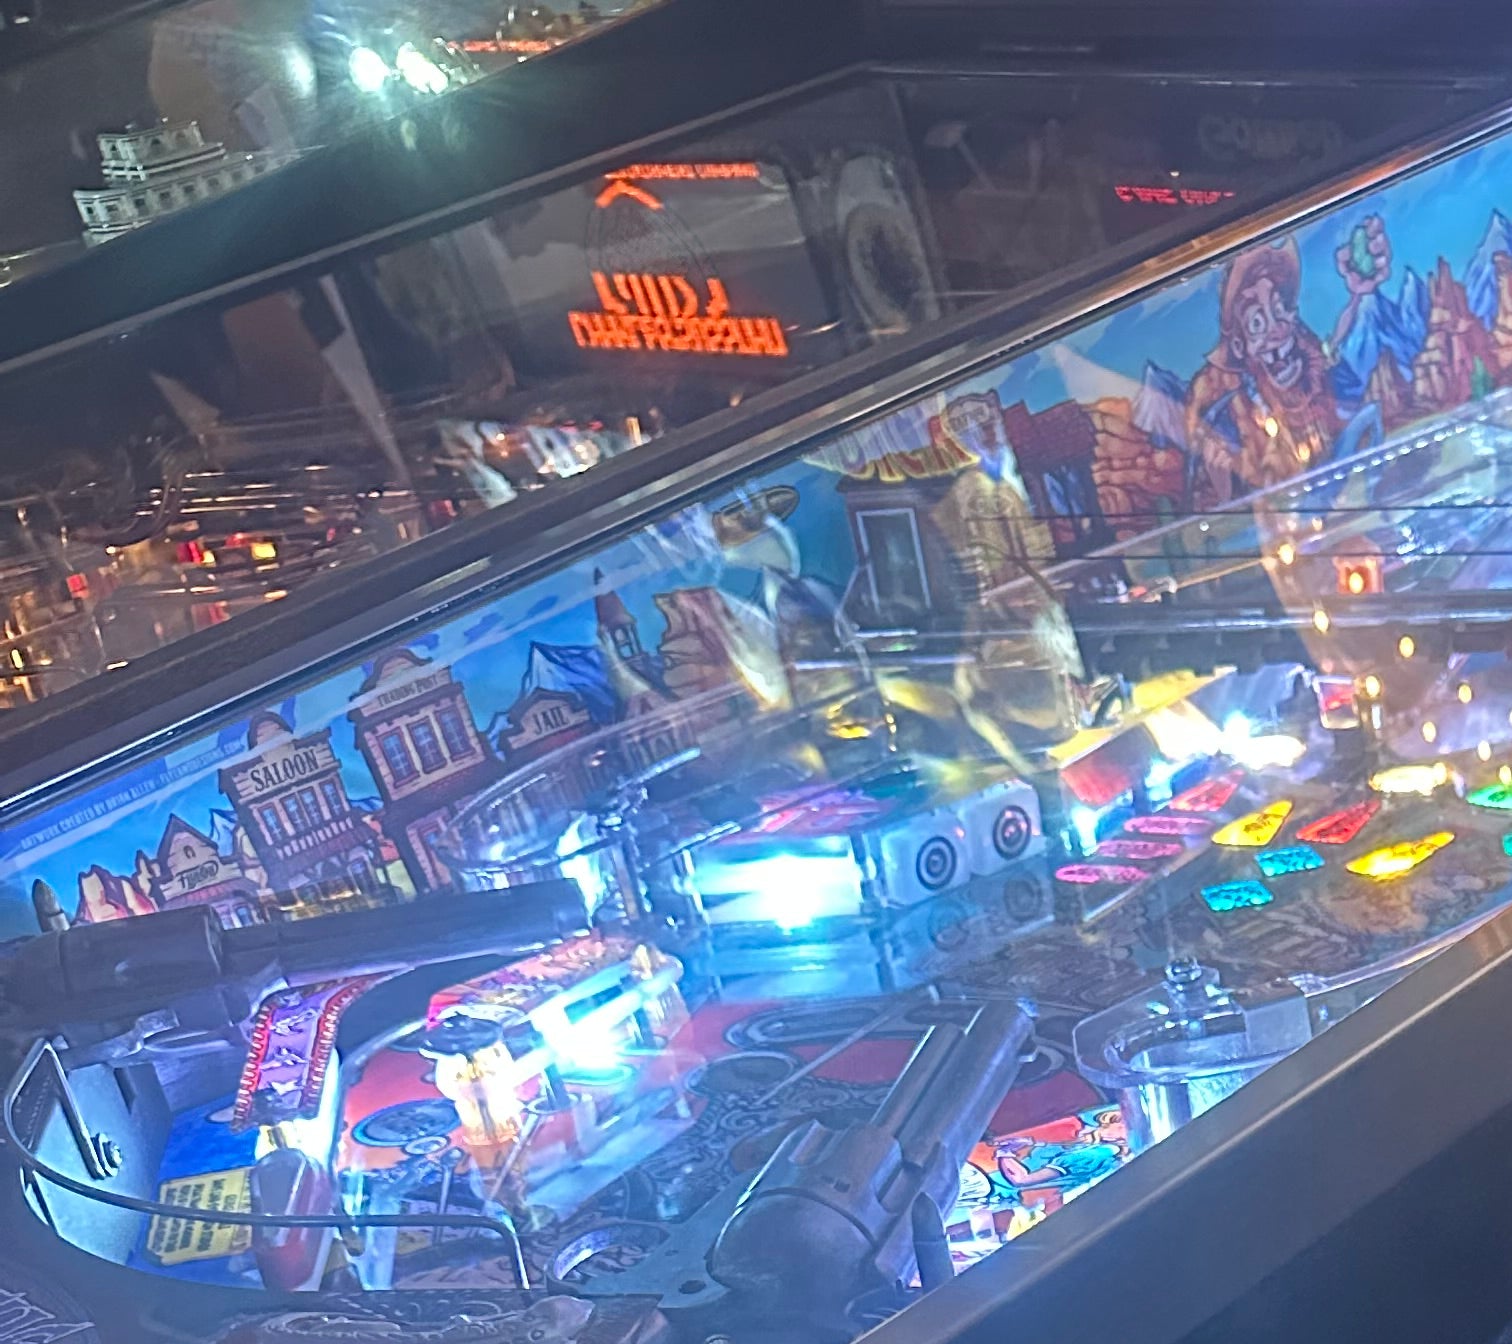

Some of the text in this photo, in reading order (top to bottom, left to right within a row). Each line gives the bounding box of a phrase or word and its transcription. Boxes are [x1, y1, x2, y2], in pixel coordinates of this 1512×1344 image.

[533, 707, 568, 732] JAIL
[249, 747, 319, 791] SALOON
[21, 825, 60, 850] ARTWORK
[58, 811, 96, 838] CREATED
